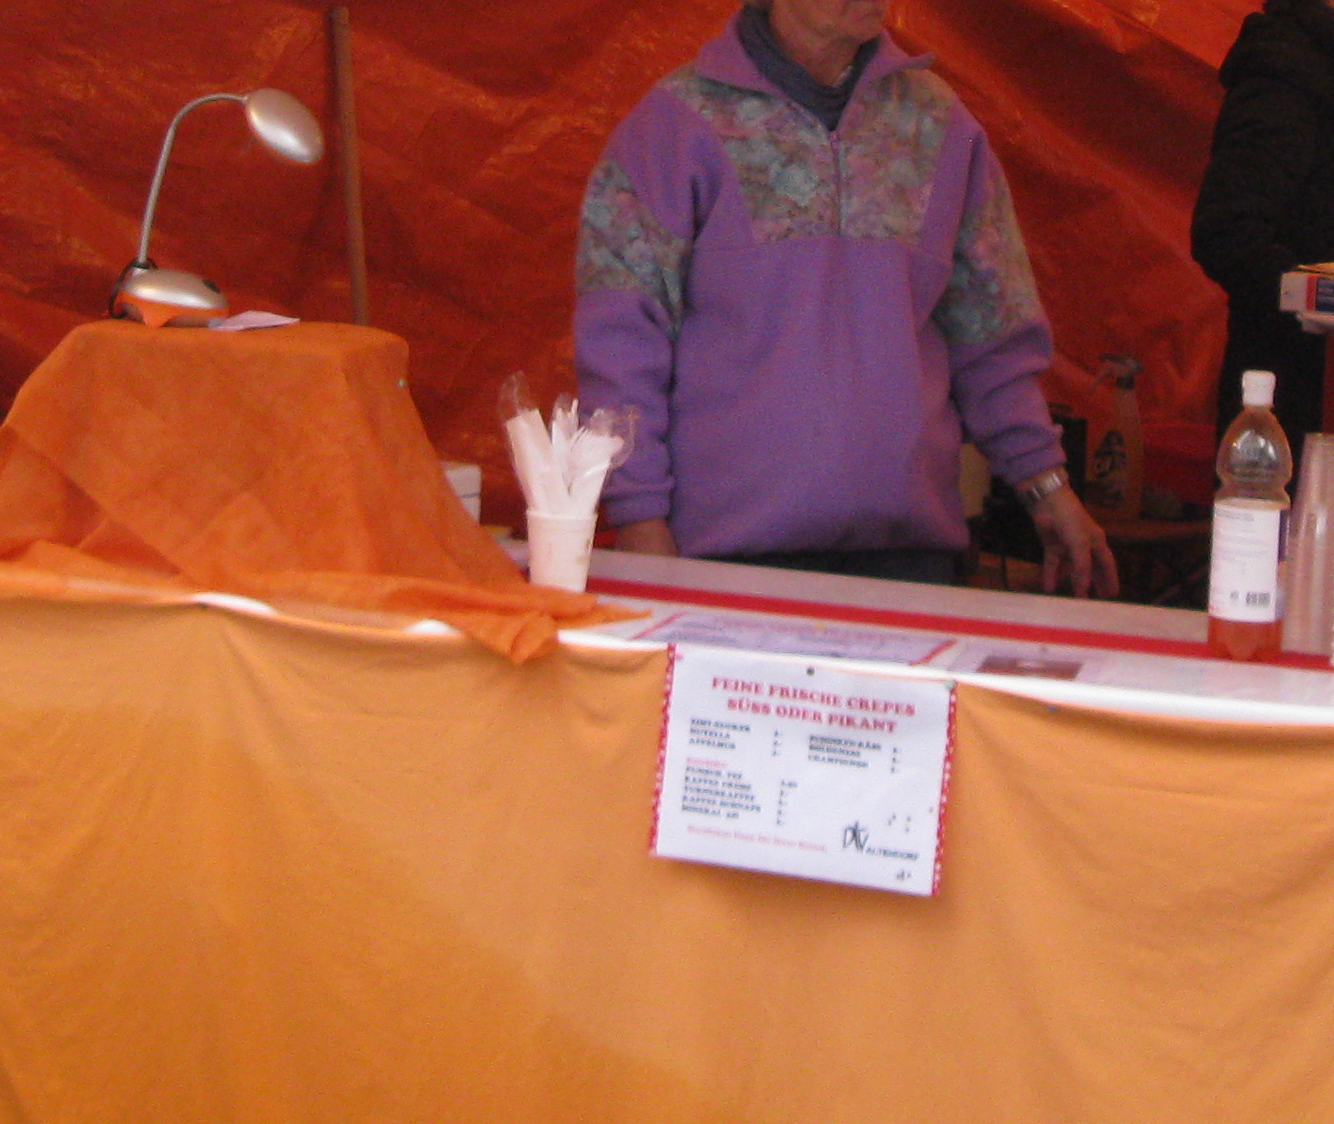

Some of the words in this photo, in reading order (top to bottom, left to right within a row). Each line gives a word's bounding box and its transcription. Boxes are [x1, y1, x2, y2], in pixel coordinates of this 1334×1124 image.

[711, 676, 764, 694] FEINE
[768, 682, 842, 708] FRISCHE
[847, 696, 916, 717] CREPES
[727, 696, 771, 715] SÜSS
[775, 705, 823, 724] ODER
[828, 712, 897, 733] PIKANT
